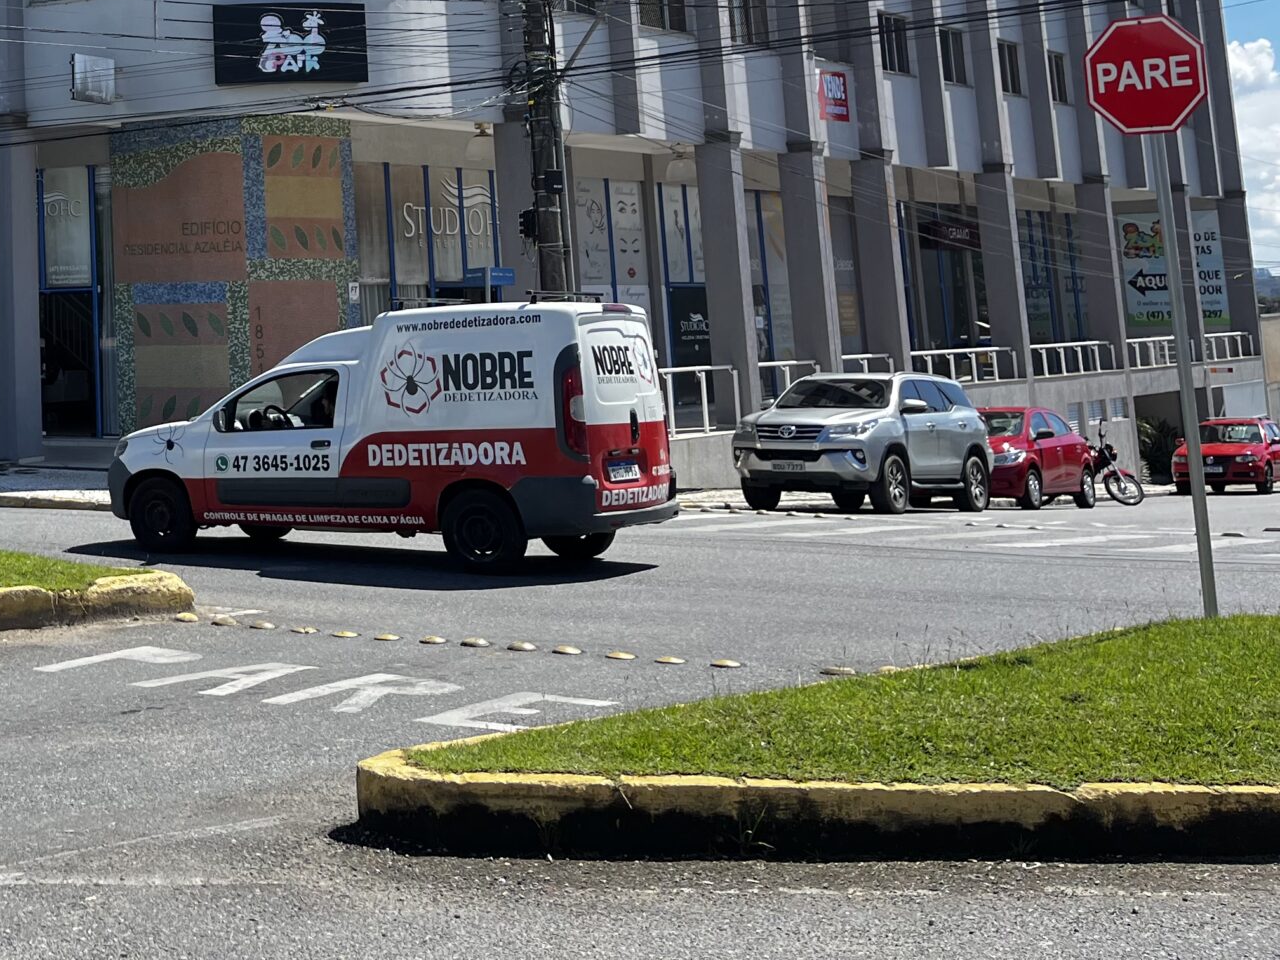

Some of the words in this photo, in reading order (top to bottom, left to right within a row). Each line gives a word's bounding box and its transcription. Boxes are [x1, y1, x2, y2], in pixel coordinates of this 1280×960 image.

[1095, 54, 1194, 95] PARE
[181, 217, 242, 236] EDIFÍCIO
[403, 202, 499, 238] STUDIOH
[1204, 232, 1217, 241] DE
[122, 241, 191, 256] RESIDENCIAL
[193, 238, 244, 254] AZALÉIA
[1136, 275, 1168, 290] AQU
[396, 314, 542, 333] www.nobrededetizadora.com
[1146, 310, 1164, 321] (47)
[592, 345, 635, 376] NOBRE
[442, 350, 535, 392] NOBRE
[598, 376, 638, 384] DEDETIZADORA
[444, 391, 539, 403] DEDETIZADORA
[232, 455, 249, 472] 47
[253, 454, 330, 472] 3645-1025
[367, 441, 527, 467] DEDETIZADORA
[203, 511, 247, 521] CONTROLE
[247, 512, 258, 521] DE
[260, 513, 293, 522] PRAGAS
[296, 514, 308, 522] DE
[309, 515, 347, 523] LIMPEZA
[347, 515, 360, 524] DE
[361, 516, 389, 524] CAIXA
[390, 513, 426, 525] D'ÁGUA
[33, 645, 620, 731] PARE
